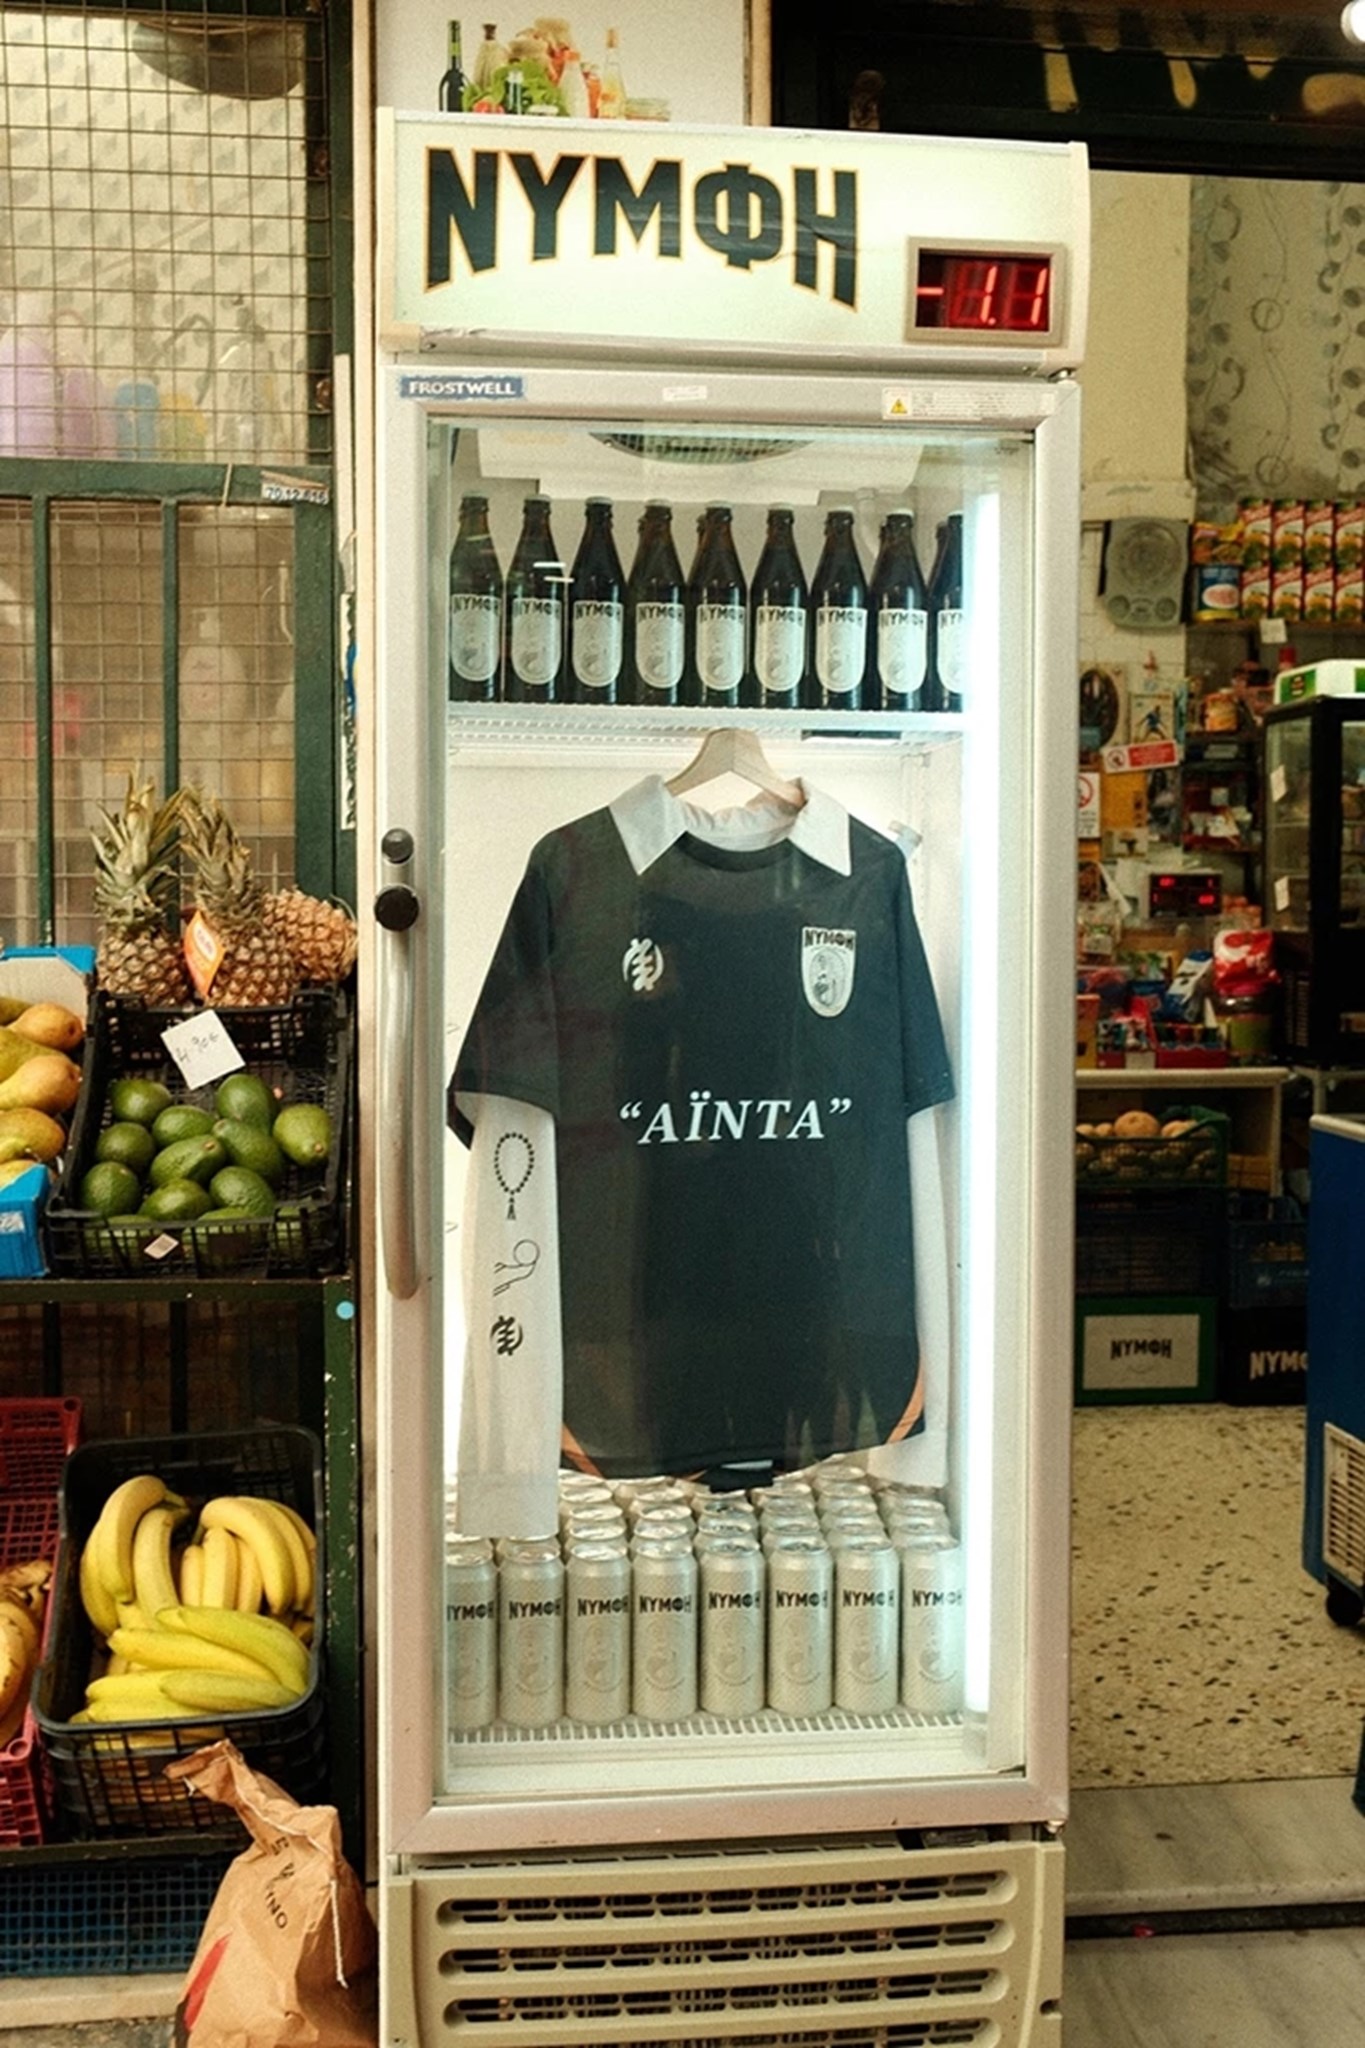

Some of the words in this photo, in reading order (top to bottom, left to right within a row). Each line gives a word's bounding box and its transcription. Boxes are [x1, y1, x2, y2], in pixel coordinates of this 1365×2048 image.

[425, 147, 858, 312] ΝΥΜΦΗ
[408, 380, 516, 395] FROSTWELL
[1110, 1338, 1173, 1361] ΝΥΜΦΗ
